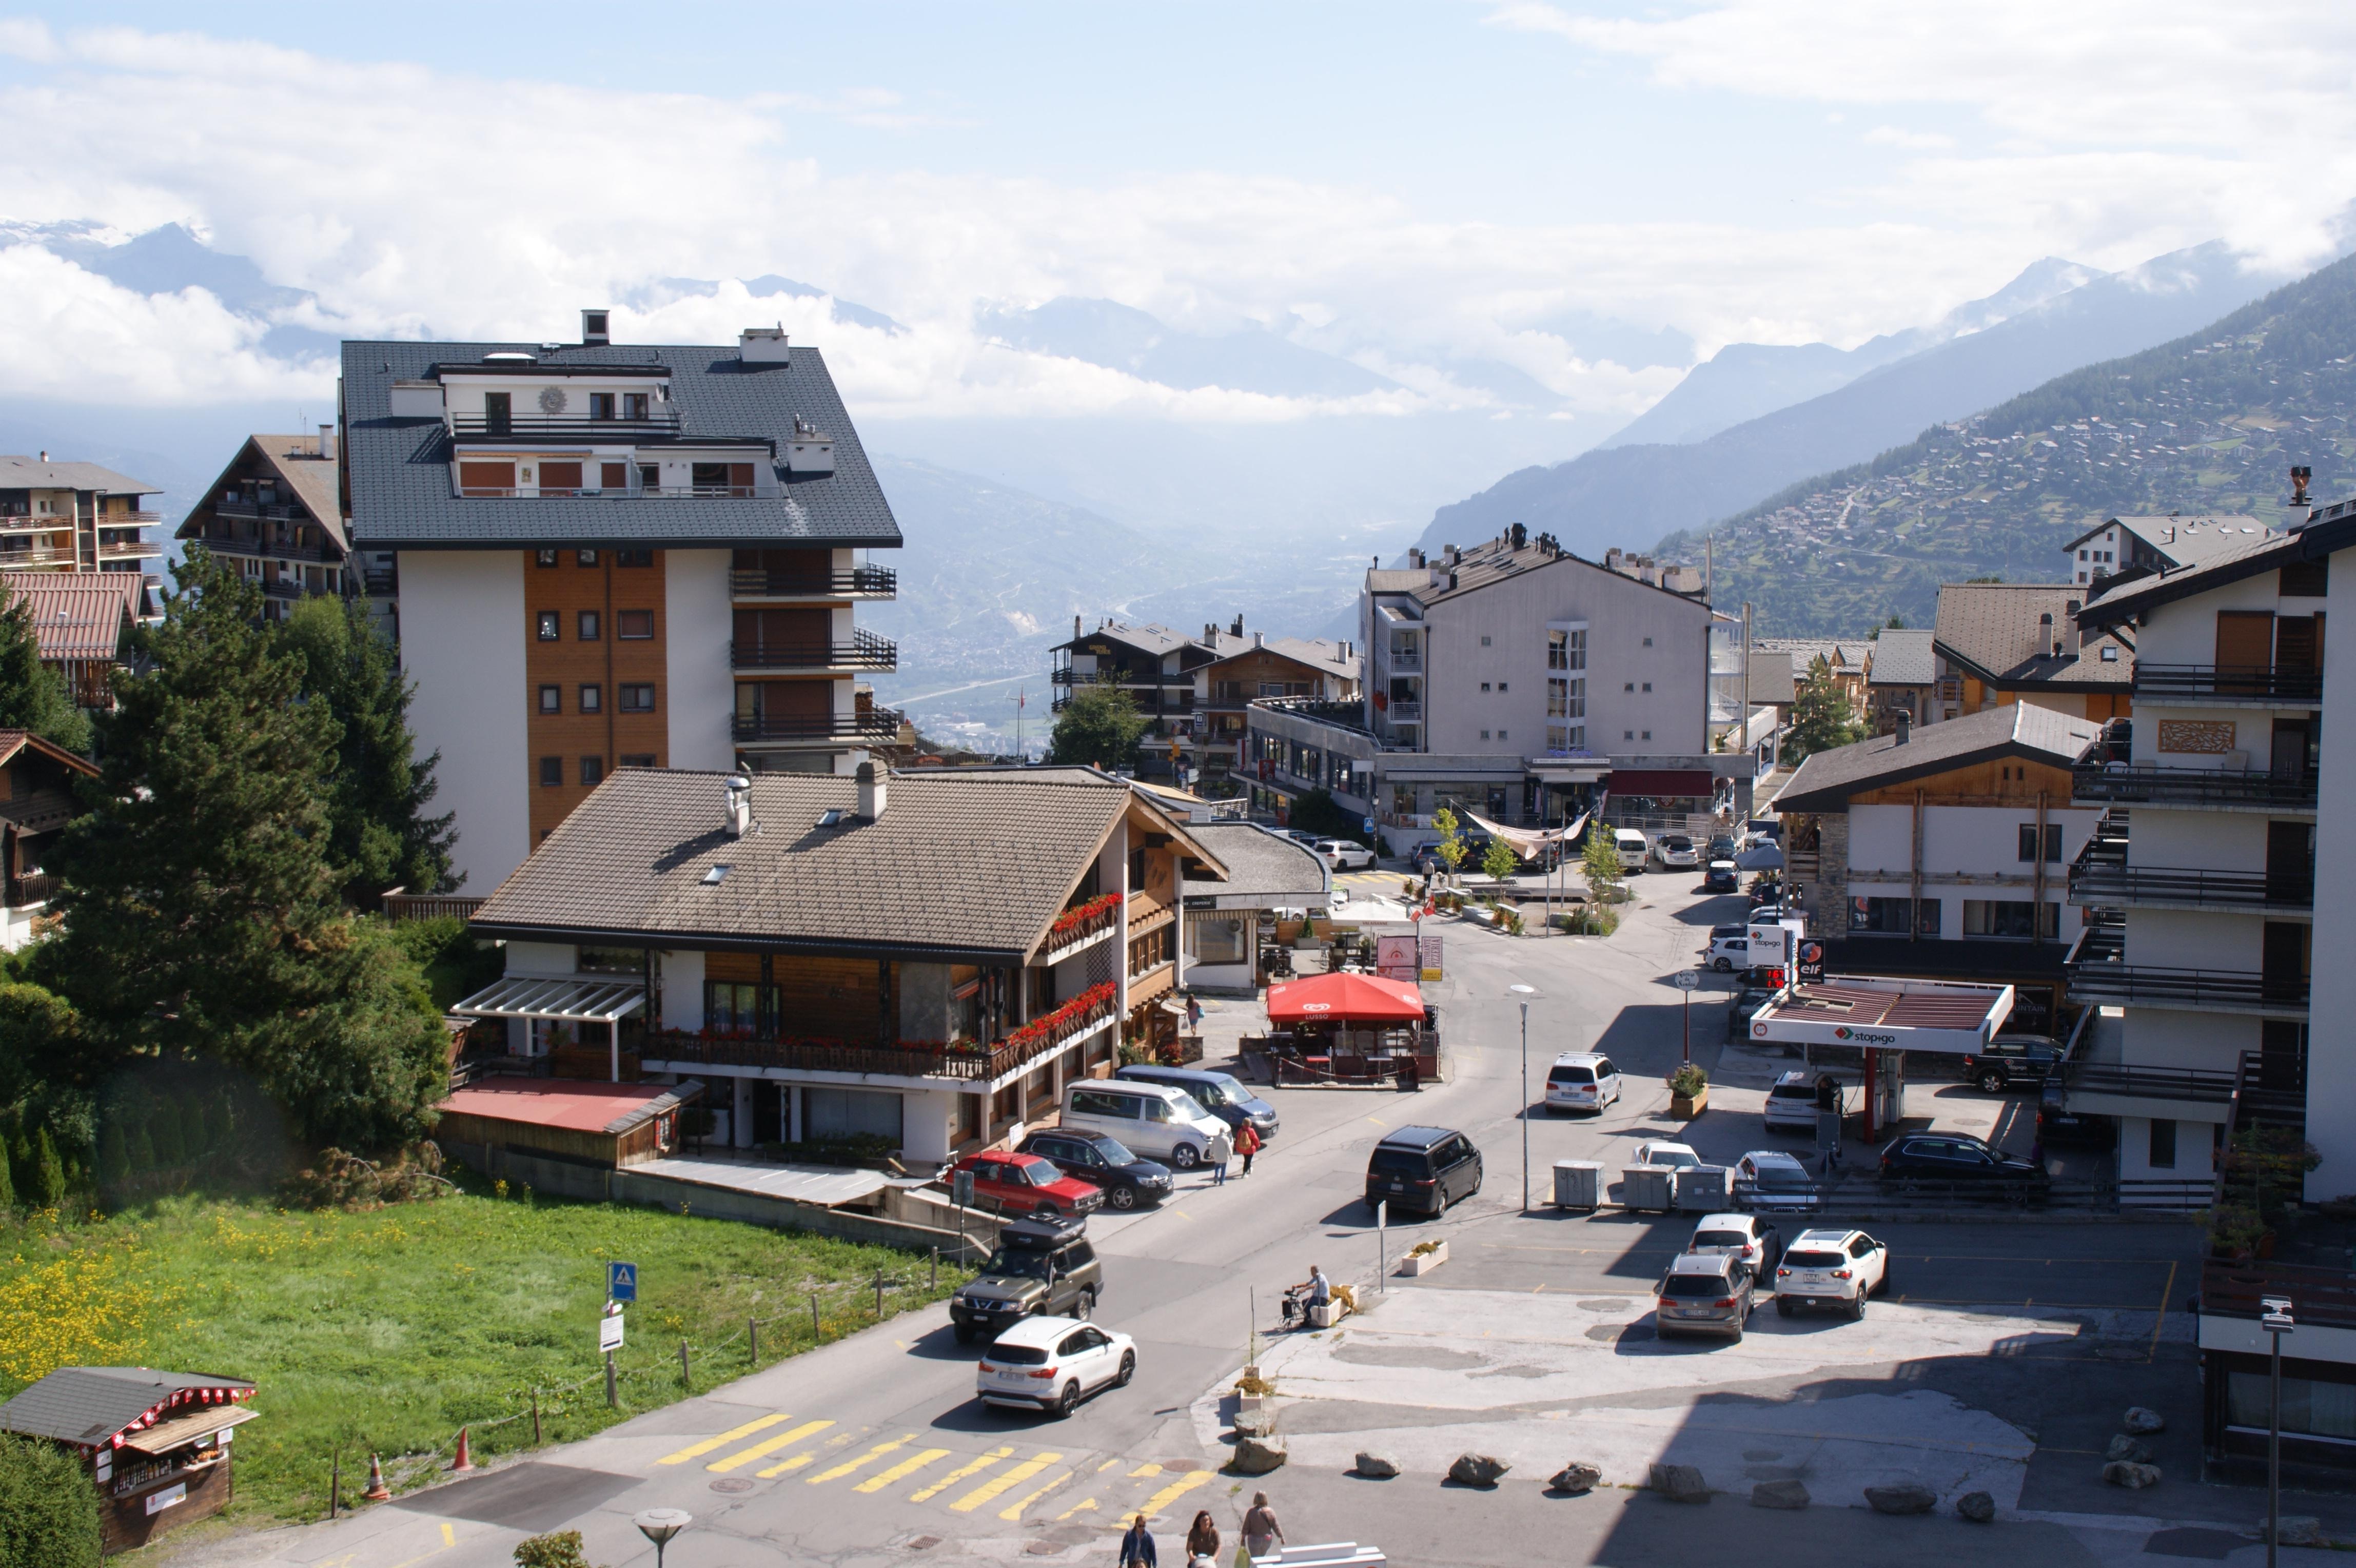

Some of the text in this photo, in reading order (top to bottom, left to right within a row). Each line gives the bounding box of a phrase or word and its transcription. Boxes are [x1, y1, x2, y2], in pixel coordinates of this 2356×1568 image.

[1754, 939, 1781, 948] stop+go
[1430, 939, 1440, 968] PIZZERIA
[1800, 965, 1821, 974] elf
[1855, 1032, 1895, 1045] stop+go
